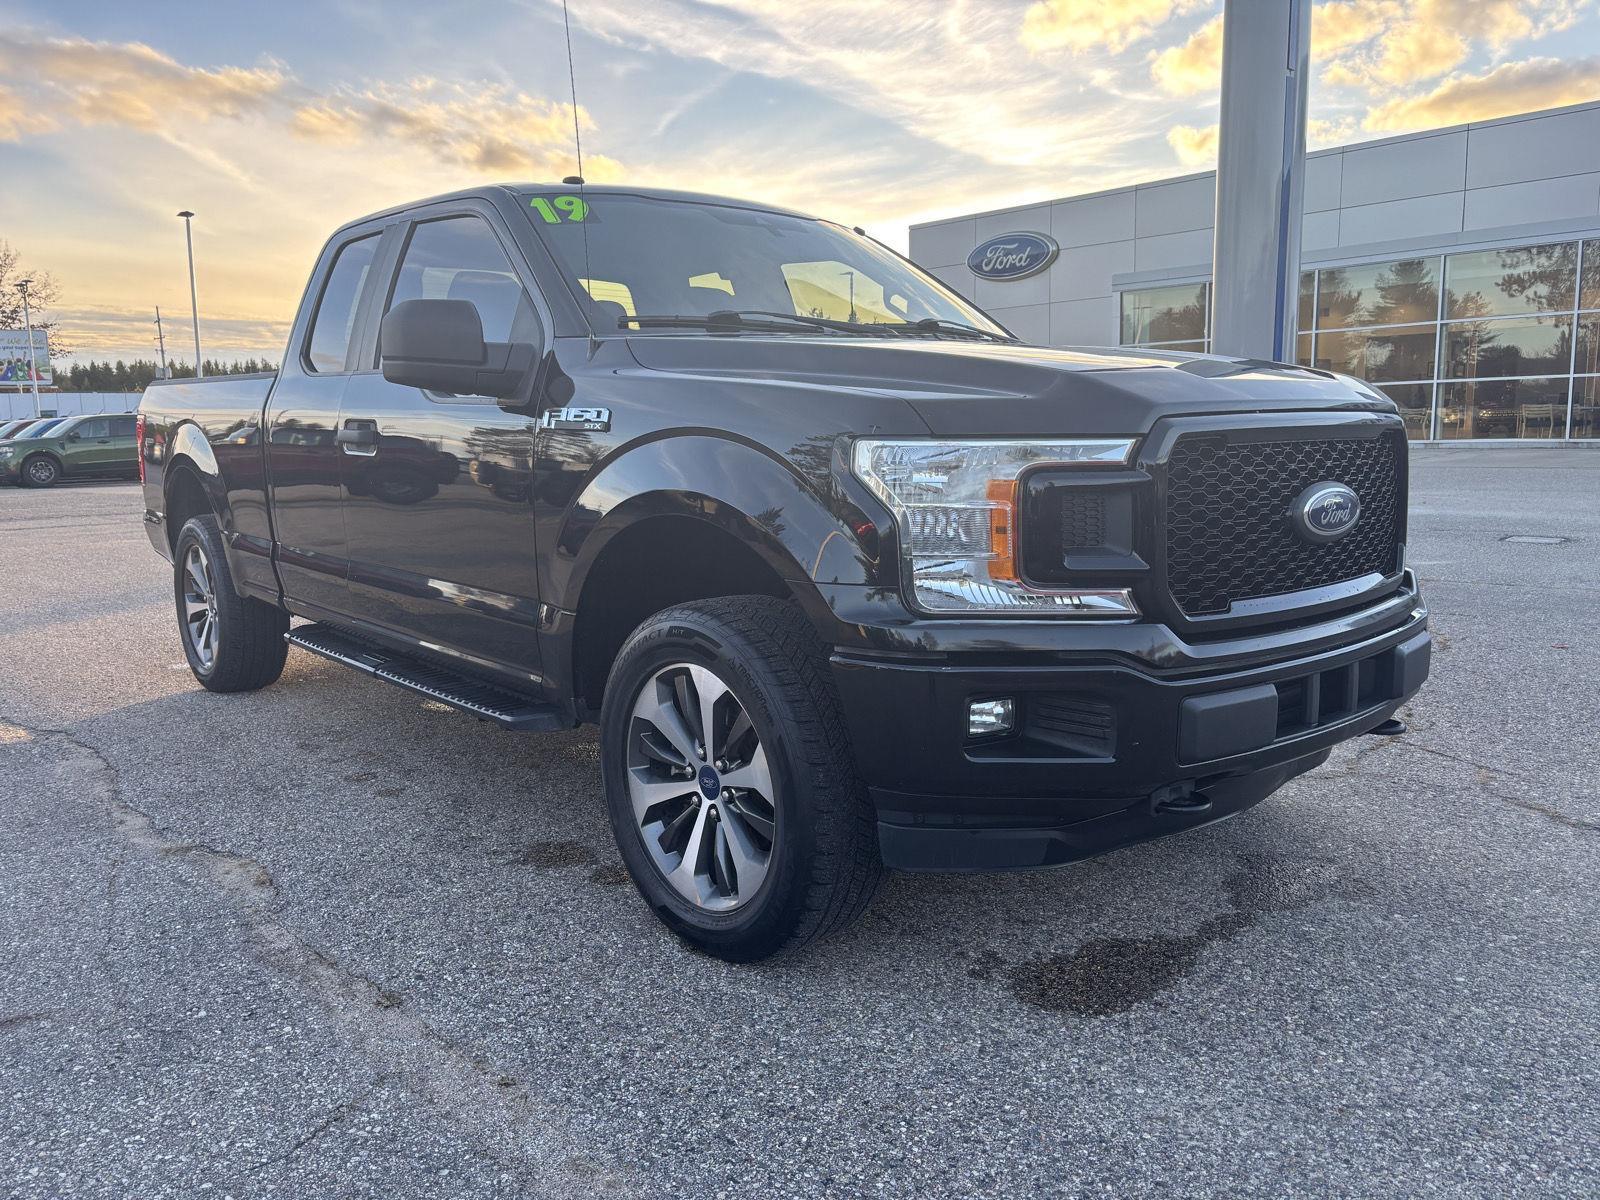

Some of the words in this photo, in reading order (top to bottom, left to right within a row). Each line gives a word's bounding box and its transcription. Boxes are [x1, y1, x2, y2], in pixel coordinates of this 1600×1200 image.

[530, 196, 589, 224] 19
[982, 243, 1031, 272] Ford
[1321, 498, 1351, 525] Ford
